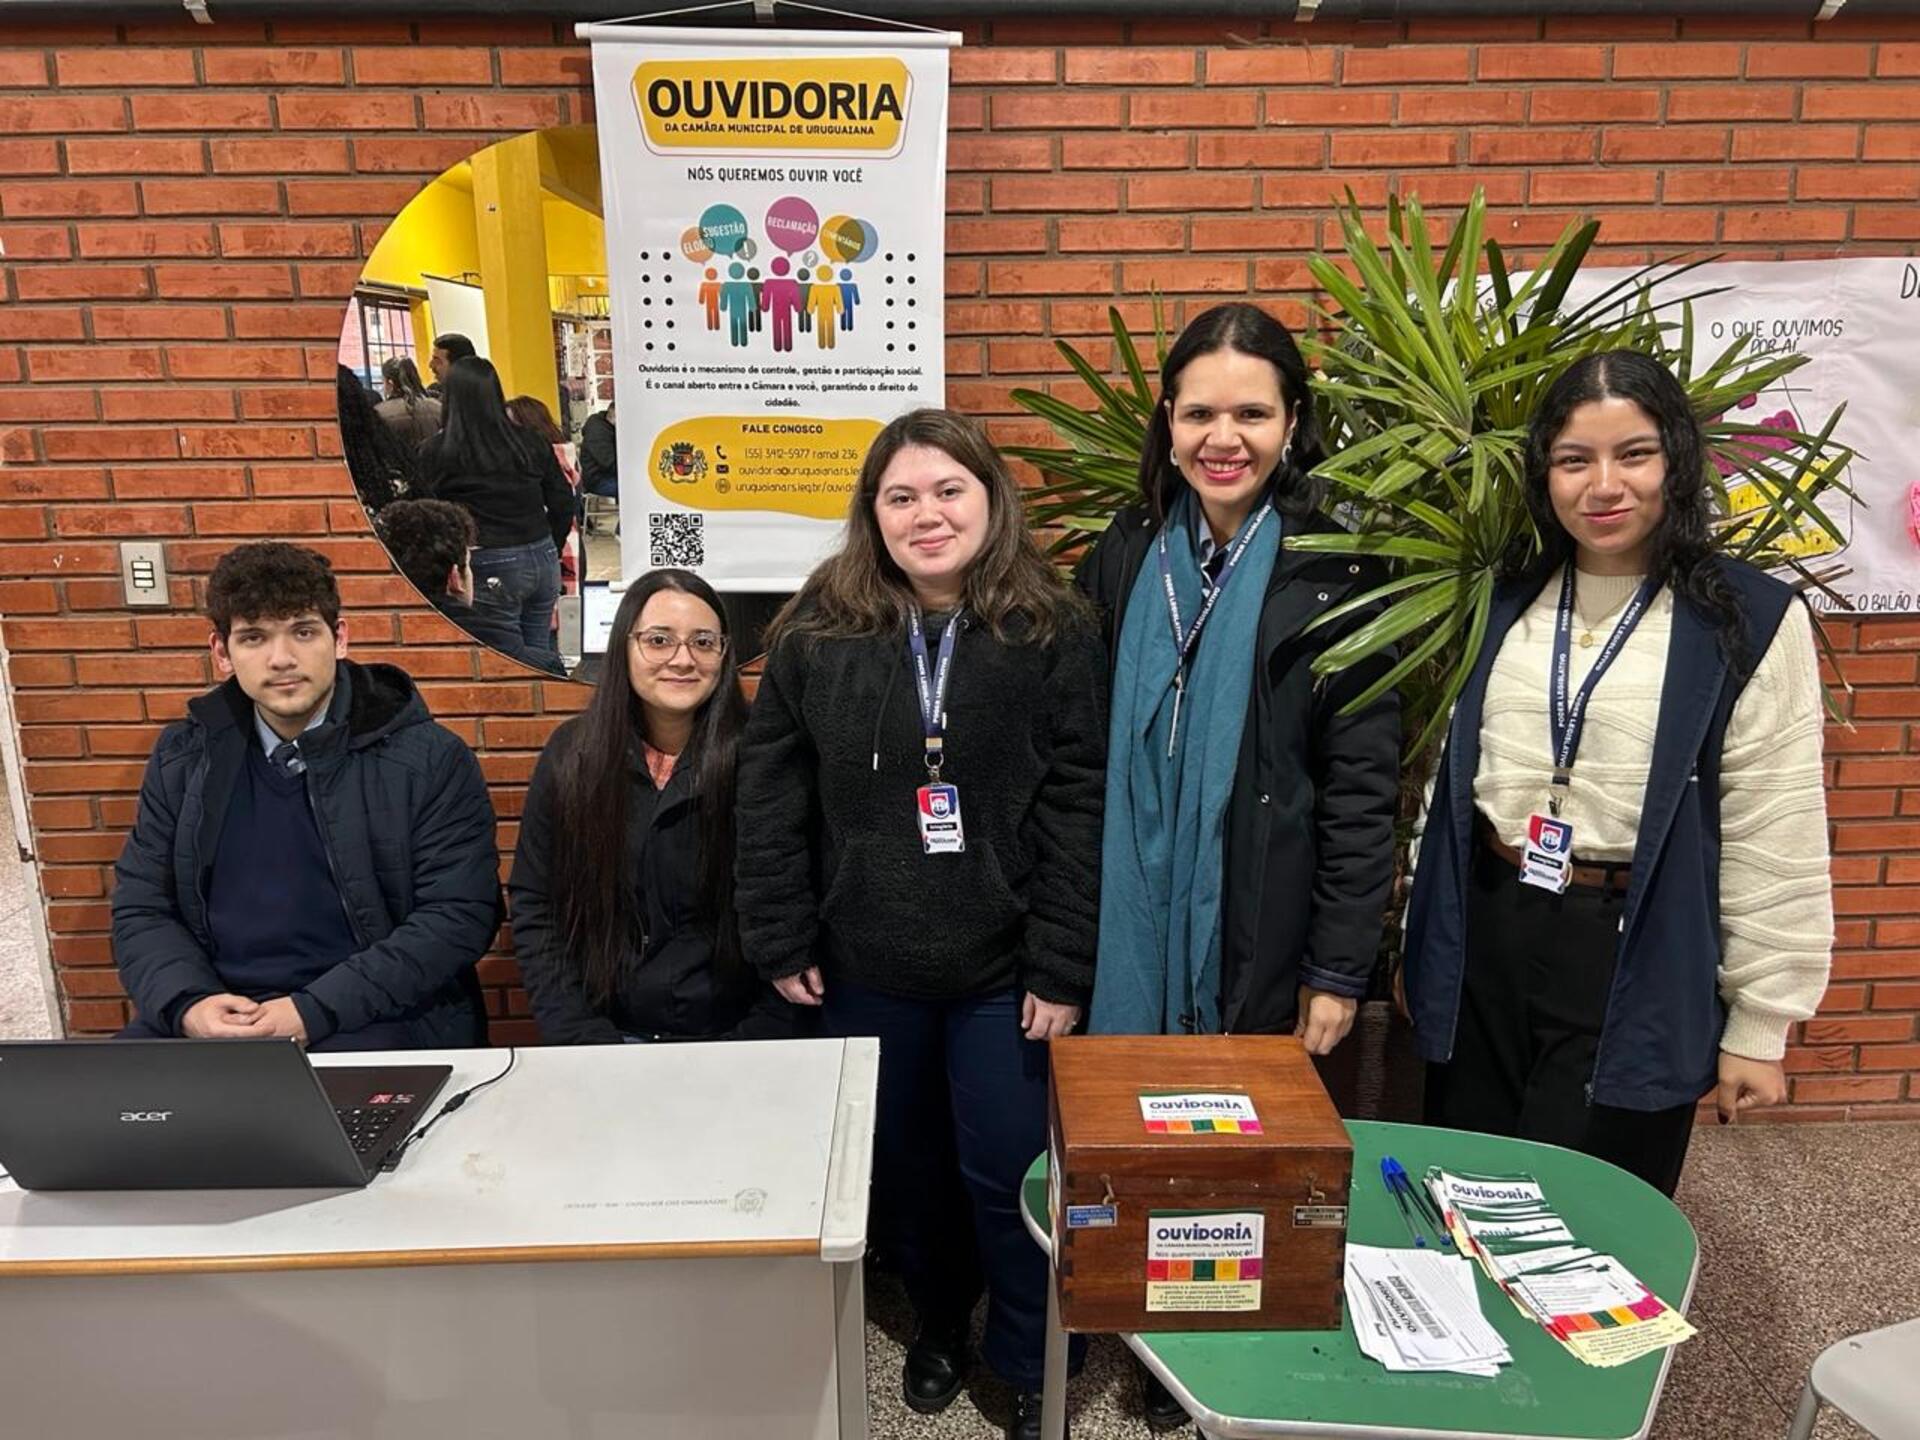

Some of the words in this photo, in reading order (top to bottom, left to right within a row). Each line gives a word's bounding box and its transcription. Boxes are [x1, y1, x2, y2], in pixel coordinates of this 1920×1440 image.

[648, 79, 903, 121] OUVIDORIA
[664, 124, 679, 132] DA
[728, 123, 786, 134] MUNICIPAL
[790, 125, 803, 134] DE
[807, 125, 875, 135] URUGUAIANA
[688, 165, 714, 181] NÓS
[718, 168, 784, 183] QUEREMOS
[789, 168, 827, 182] OUVIR
[832, 167, 863, 183] VOCÊ
[702, 221, 746, 239] SUGESTÃO
[767, 215, 818, 236] RECLAMAÇÃO
[1711, 321, 1724, 339] O
[1732, 320, 1764, 338] QUE
[1772, 319, 1845, 338] OUVIMOS
[1751, 338, 1775, 354] POR
[639, 364, 679, 373] Ouvidoria
[698, 365, 746, 374] mecanismo
[748, 365, 759, 374] de
[761, 365, 800, 376] controle,
[802, 366, 832, 376] gestão
[842, 366, 894, 378] participação
[897, 367, 923, 376] social.
[646, 378, 652, 389] É
[662, 381, 685, 389] canal
[687, 381, 716, 390] aberto
[718, 382, 742, 390] entre
[752, 380, 786, 390] Câmara
[821, 382, 868, 393] garantindo
[877, 382, 906, 391] direito
[907, 383, 919, 391] do
[765, 397, 801, 407] cidadão.
[742, 425, 770, 433] FALE
[773, 425, 823, 434] CONOSCO
[766, 448, 810, 459] 3412-5977
[812, 449, 839, 460] ramal
[1858, 595, 1869, 611] O
[1871, 590, 1912, 612] BALÃO
[1622, 602, 1642, 625] PODER
[1595, 622, 1627, 672] LEGISLATIVO
[1557, 653, 1567, 703] LEGISLATIVO
[1572, 691, 1585, 716] PODER
[1559, 714, 1577, 769] LEGISLATIVO
[120, 1111, 173, 1122] acer
